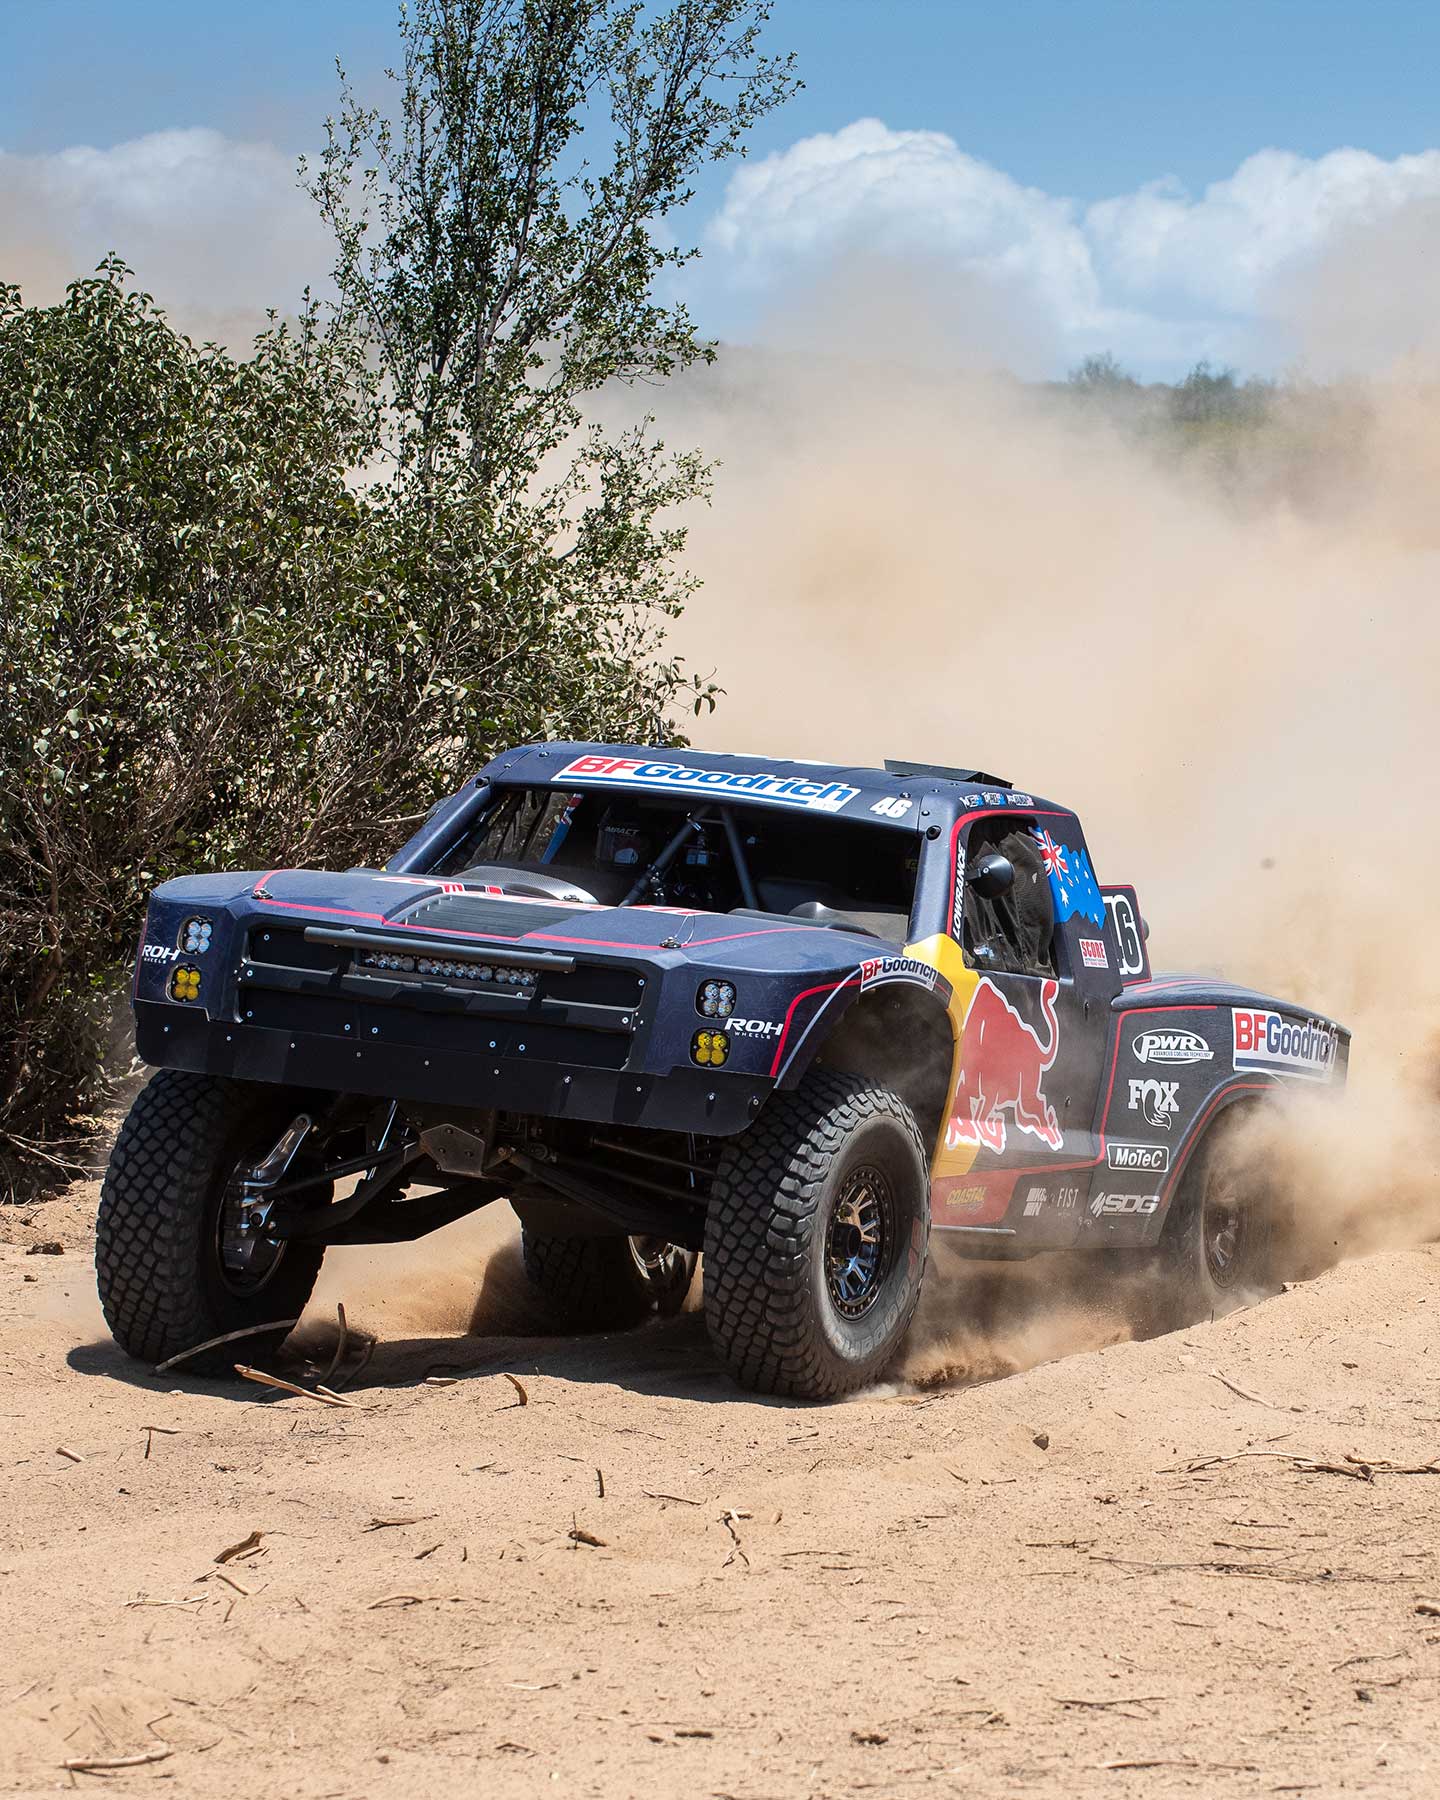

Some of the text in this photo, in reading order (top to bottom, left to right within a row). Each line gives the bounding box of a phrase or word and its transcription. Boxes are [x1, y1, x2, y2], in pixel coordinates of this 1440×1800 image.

[568, 757, 853, 801] BFGoodrich
[870, 797, 913, 818] 46
[952, 840, 966, 940] LOWRANCE
[142, 945, 180, 960] ROH
[1081, 941, 1105, 959] SCORE
[861, 957, 938, 982] BFGoodrich
[725, 1018, 784, 1036] ROH
[1140, 1035, 1199, 1055] PWR
[1235, 1013, 1337, 1065] BFGoodrich
[1128, 1079, 1180, 1113] FOX
[1115, 1150, 1163, 1168] MoTeC
[1057, 1188, 1079, 1209] FIST
[1103, 1194, 1160, 1214] SDG
